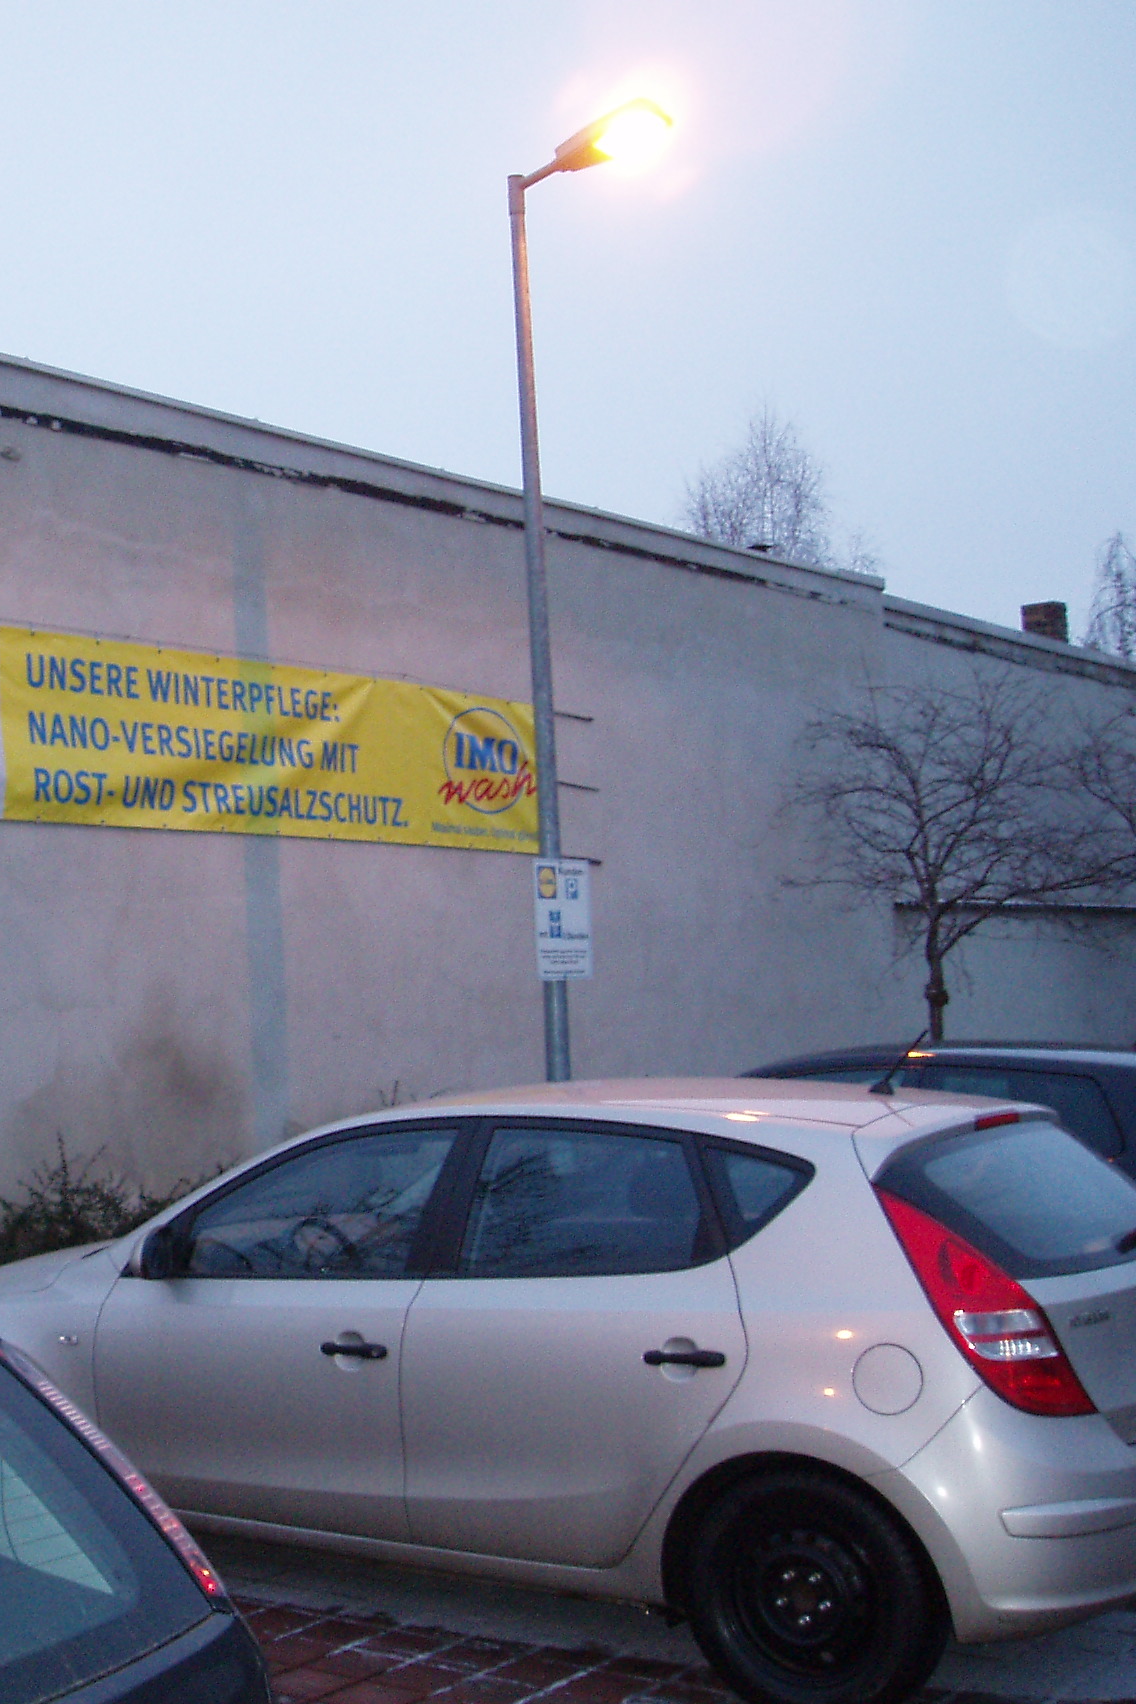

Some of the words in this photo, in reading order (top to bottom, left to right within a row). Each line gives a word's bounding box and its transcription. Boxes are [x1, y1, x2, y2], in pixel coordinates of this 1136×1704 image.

[26, 653, 140, 699] UNSERE
[147, 669, 340, 722] WINTERPFLEGE:
[28, 711, 314, 769] NANO-VERSIEGELUNG
[320, 741, 359, 773] MIT
[454, 732, 519, 774] IMO
[33, 767, 115, 805] ROST-
[122, 776, 175, 811] UND
[182, 780, 409, 827] STREUSALZSCHUTZ.
[438, 760, 537, 804] wash
